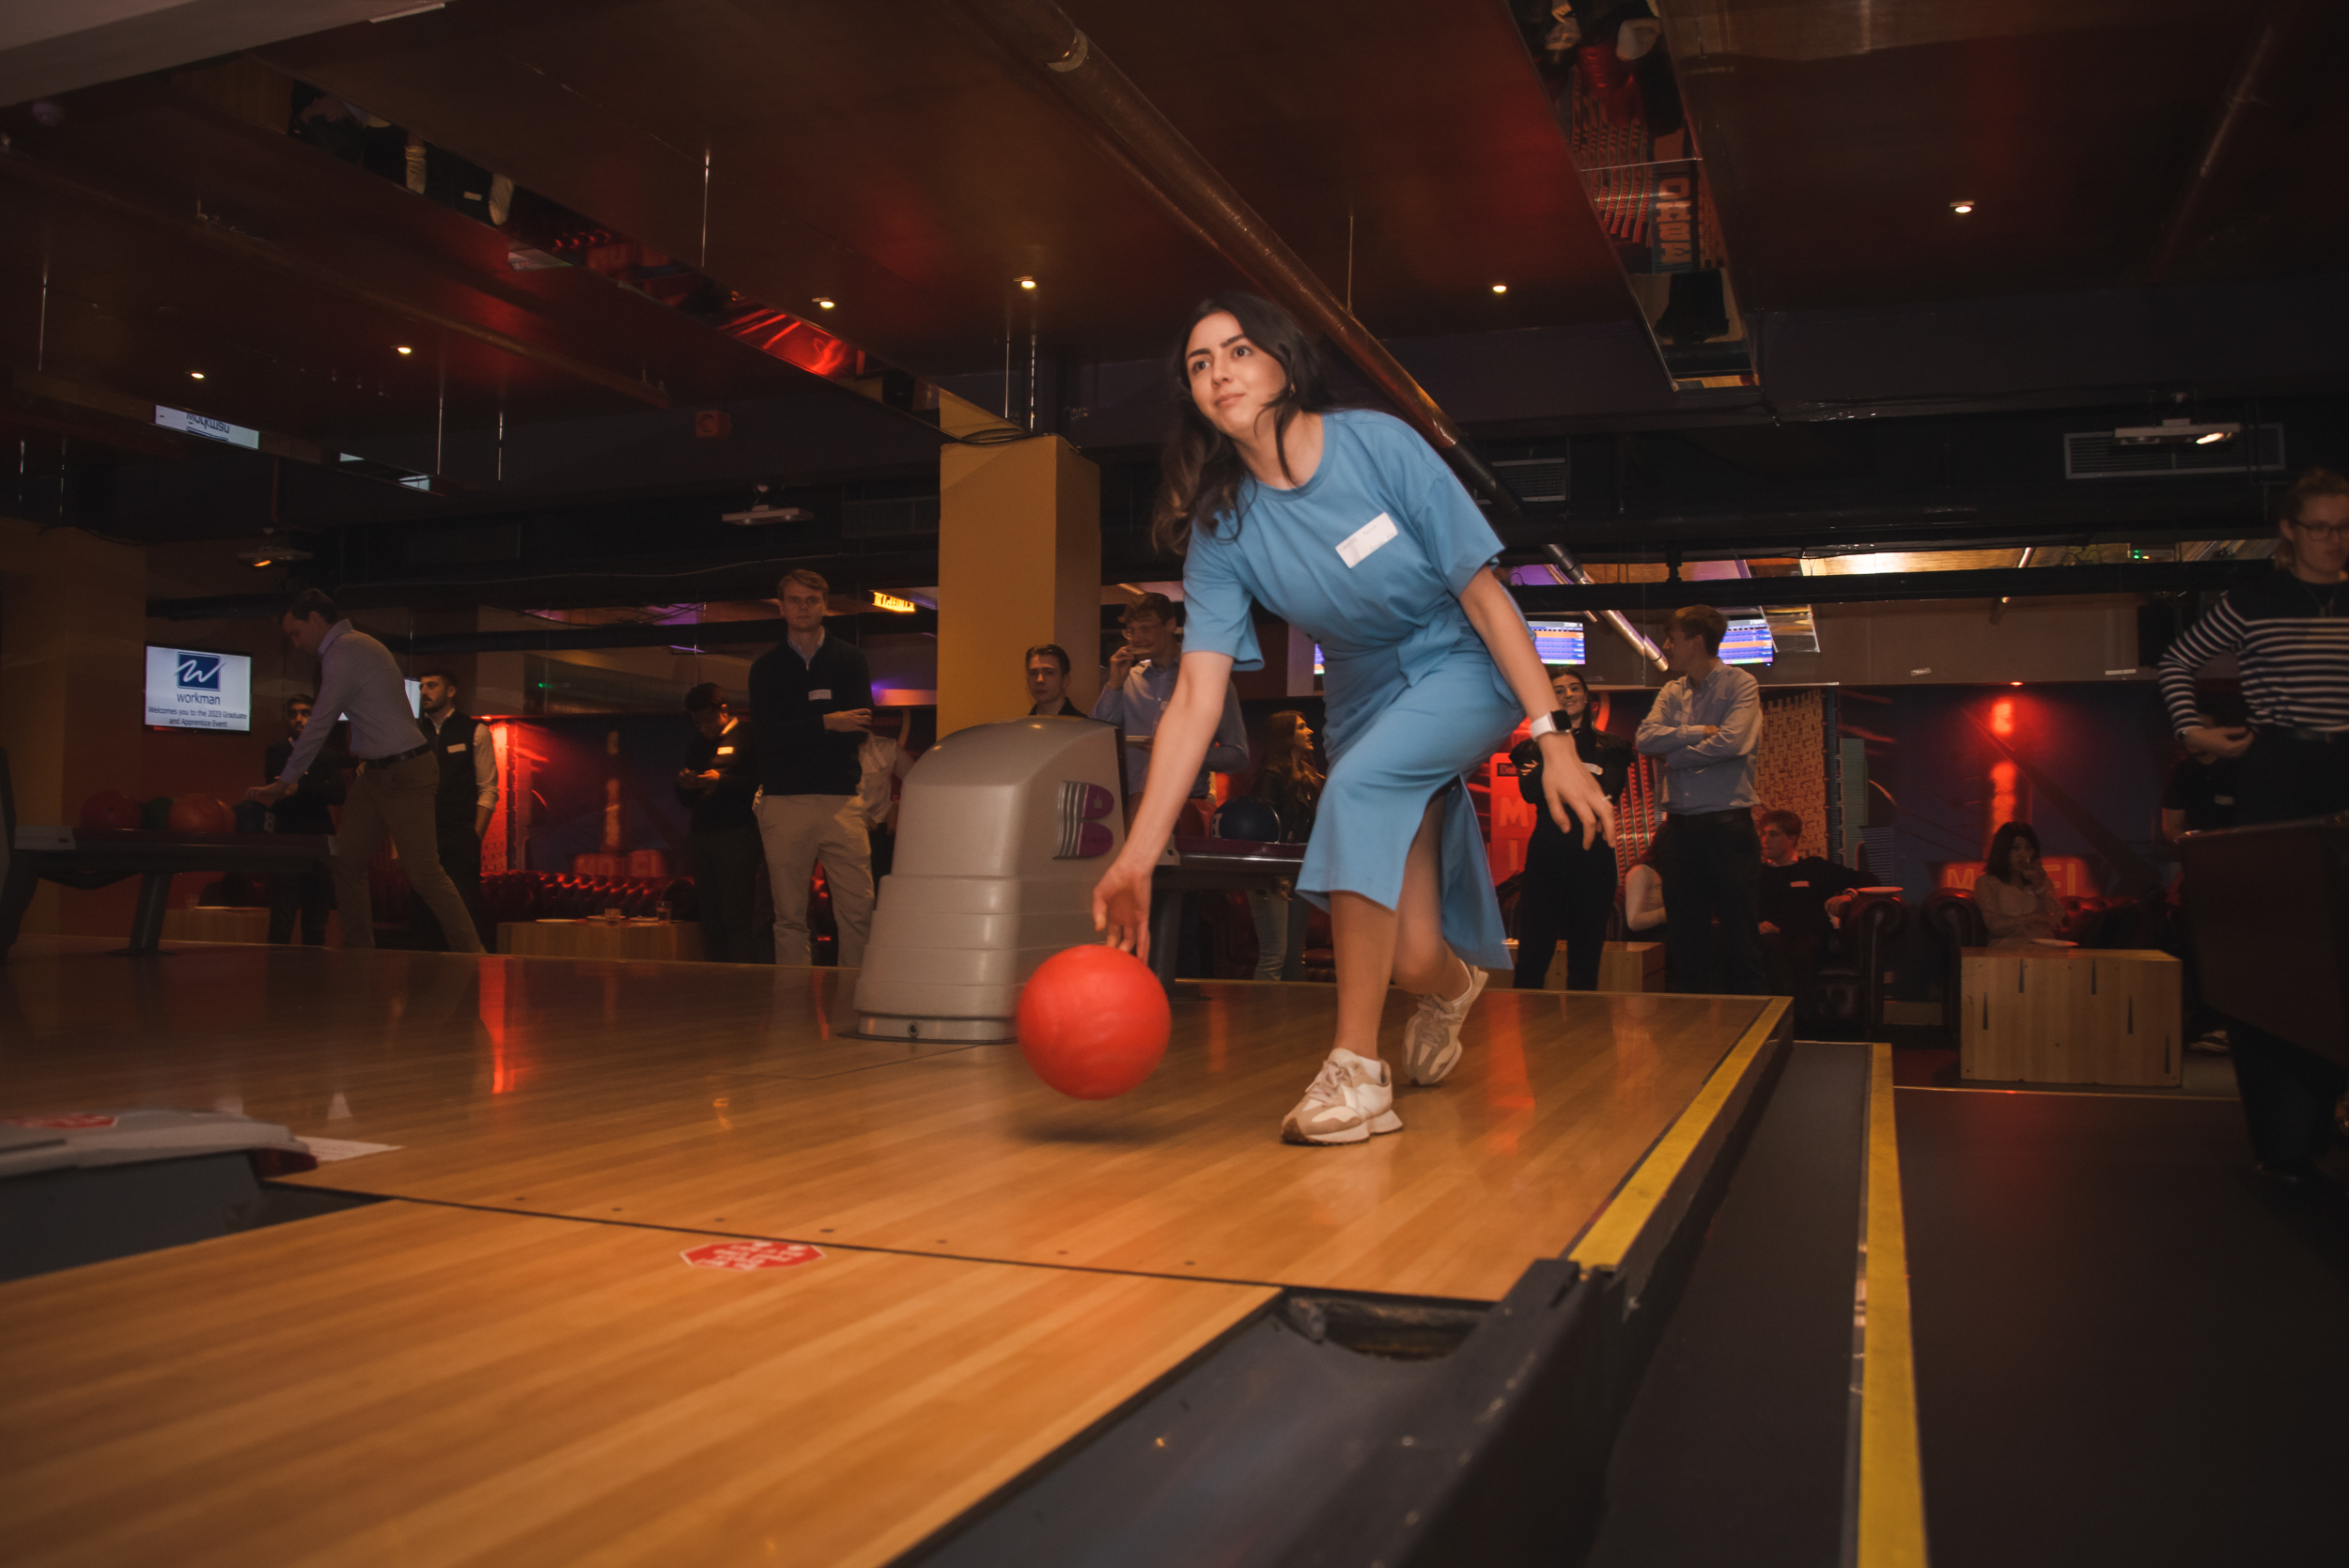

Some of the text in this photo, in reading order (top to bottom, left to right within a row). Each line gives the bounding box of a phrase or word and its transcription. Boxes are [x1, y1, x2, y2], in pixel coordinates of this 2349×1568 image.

[177, 692, 221, 706] workman
[148, 706, 178, 715] Welcomes
[222, 711, 247, 720] Graduate
[180, 718, 211, 727] Apprentice
[211, 720, 227, 728] Event
